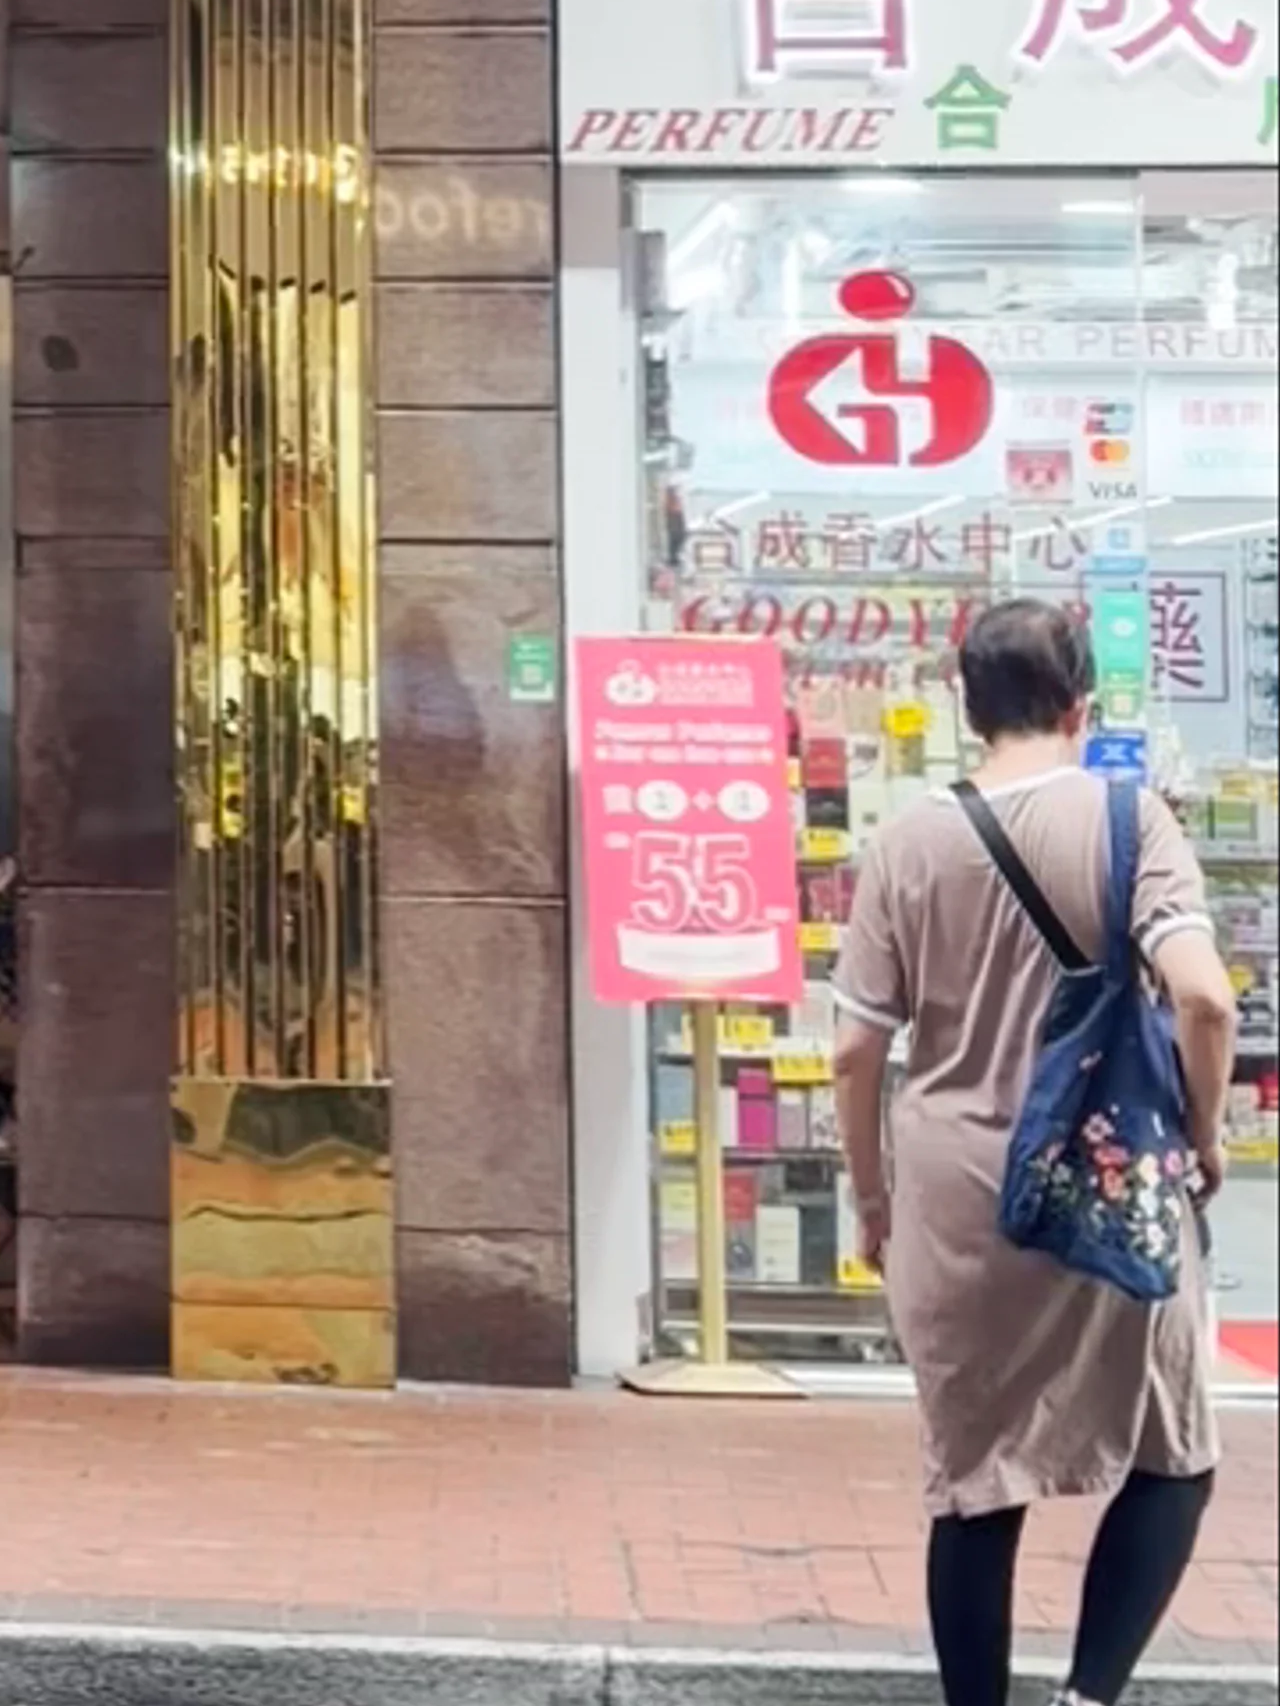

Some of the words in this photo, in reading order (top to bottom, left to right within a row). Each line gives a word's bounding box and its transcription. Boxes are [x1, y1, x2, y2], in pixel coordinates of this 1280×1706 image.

[566, 108, 894, 153] PERFUME
[693, 508, 1088, 575] 合成香水中心
[631, 830, 758, 933] 55
